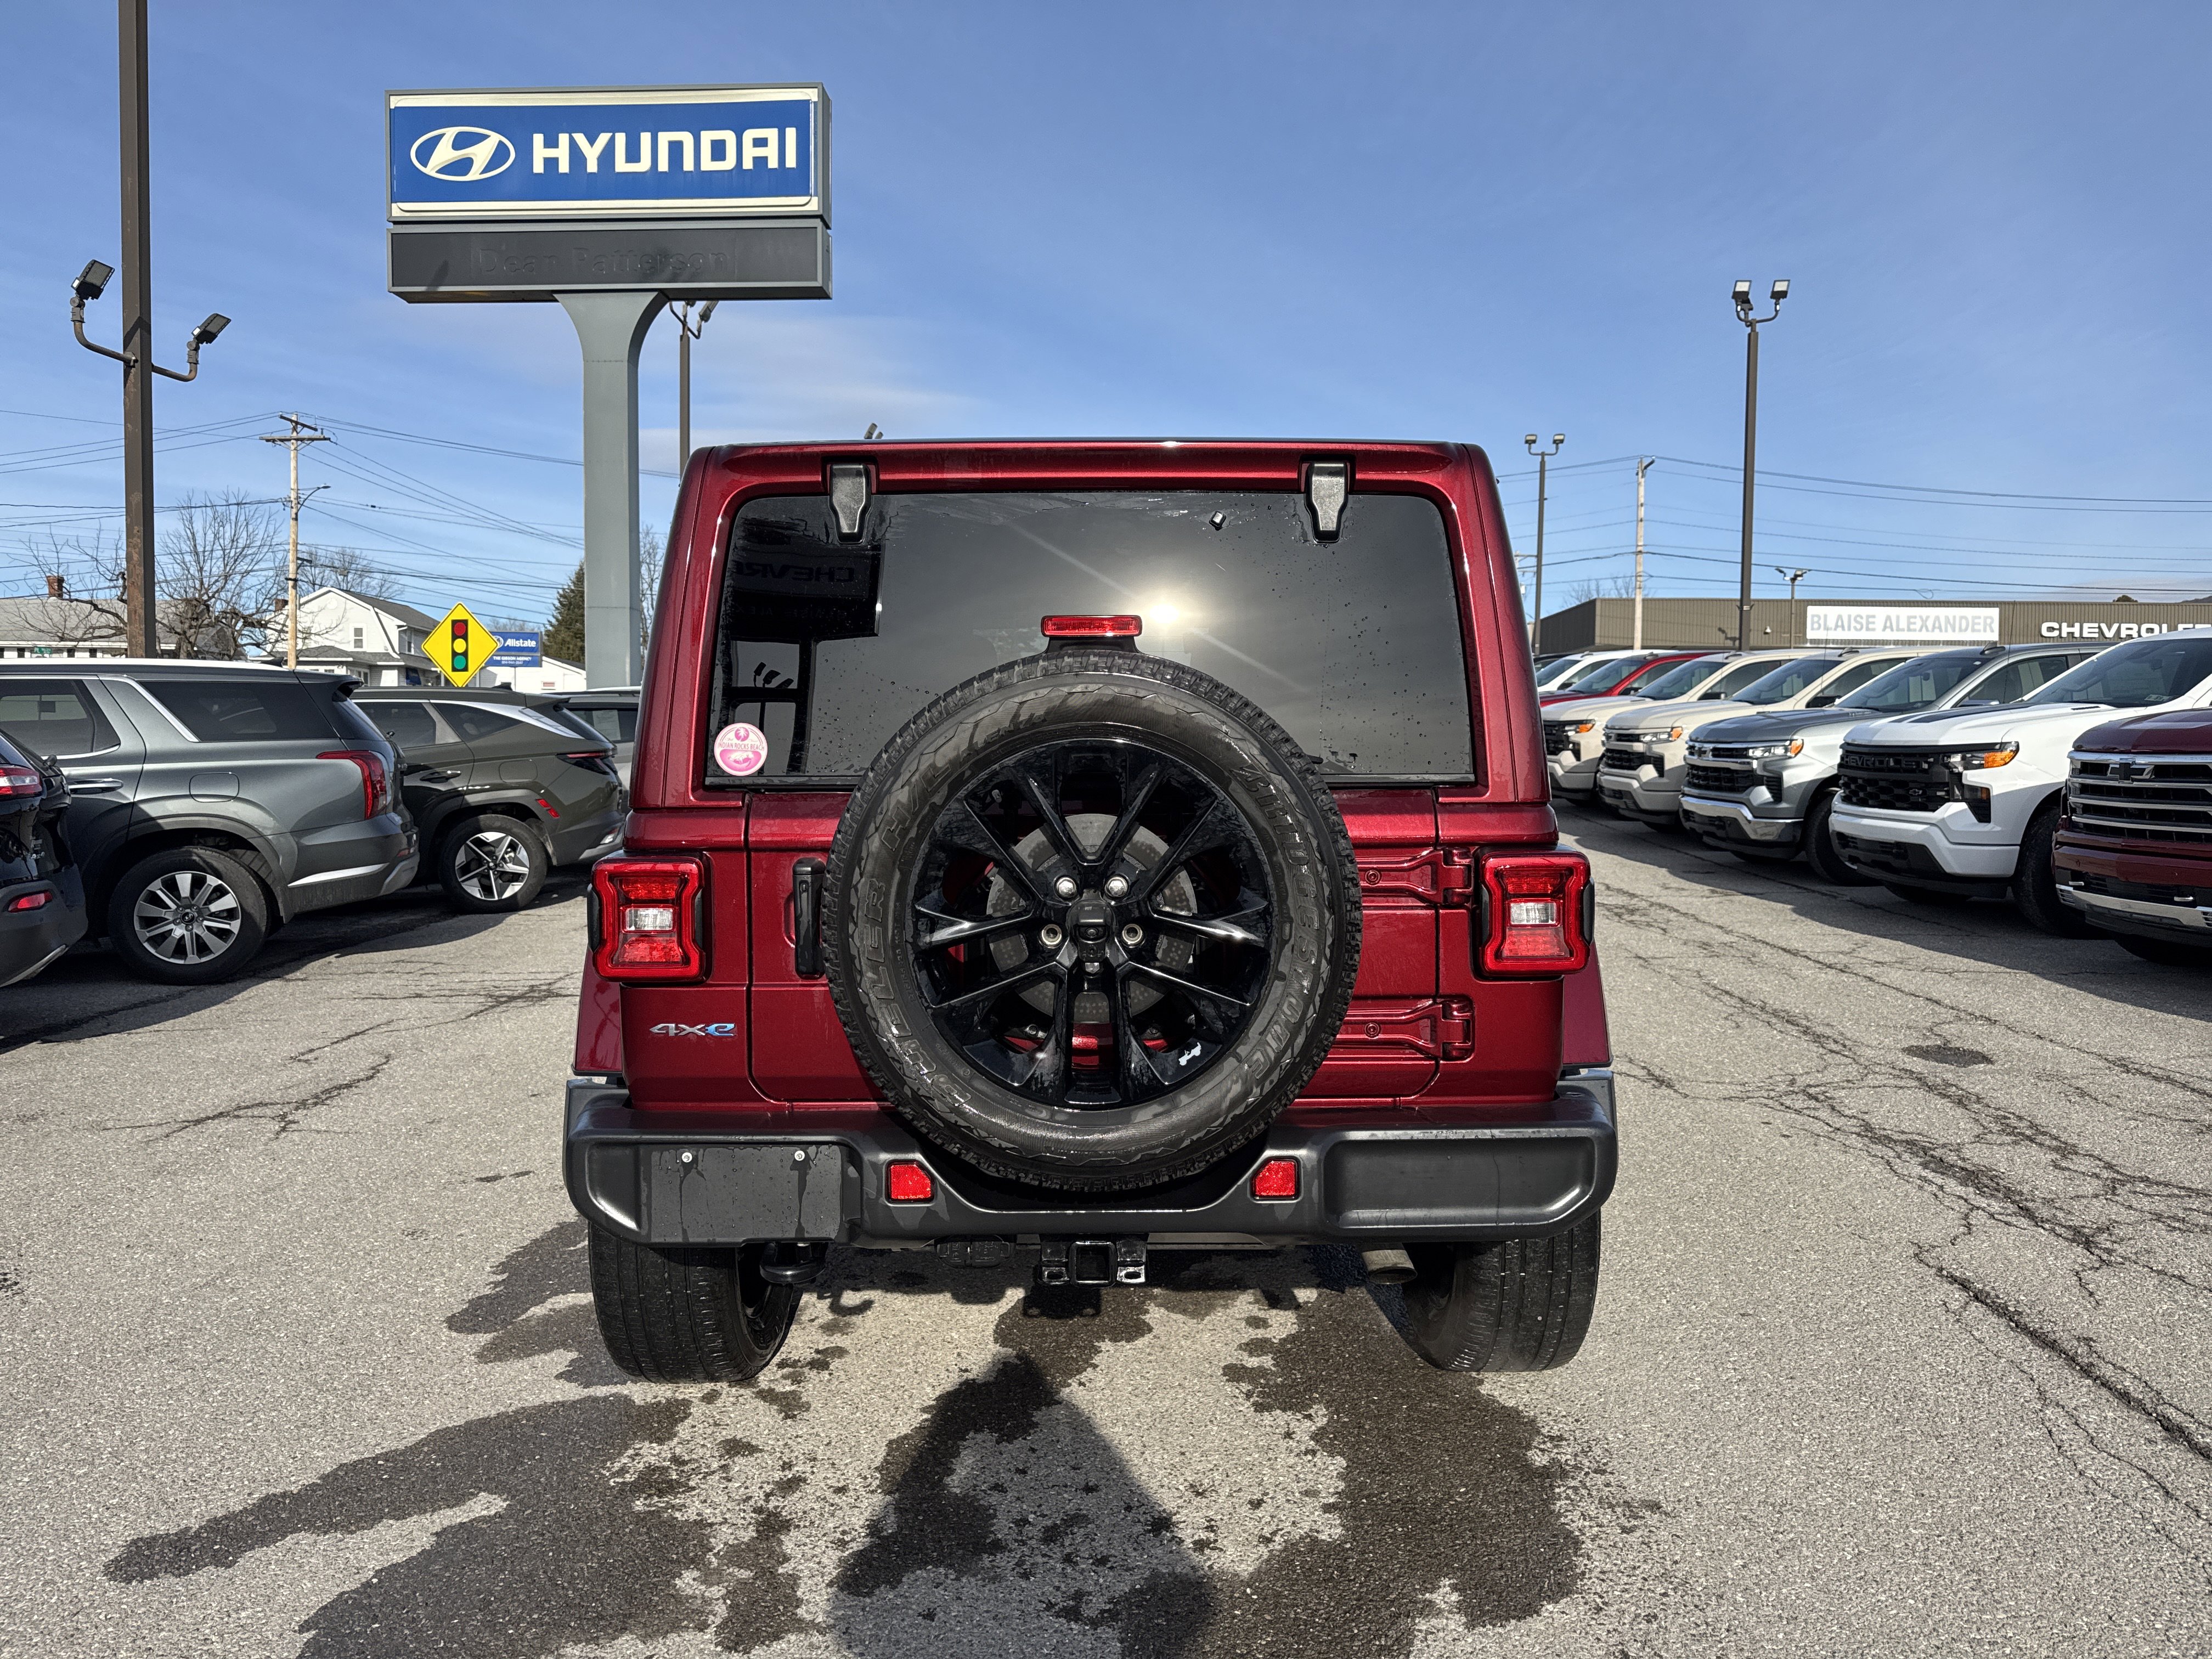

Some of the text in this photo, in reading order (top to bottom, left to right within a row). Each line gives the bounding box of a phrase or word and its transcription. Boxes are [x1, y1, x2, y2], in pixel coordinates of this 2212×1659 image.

[533, 127, 797, 174] HYUNDAI
[1810, 614, 1995, 633] BLAISE ALEXANDER
[2041, 622, 2212, 639] CHEVROL
[505, 638, 537, 647] Allstate
[864, 878, 972, 1107] DUELER
